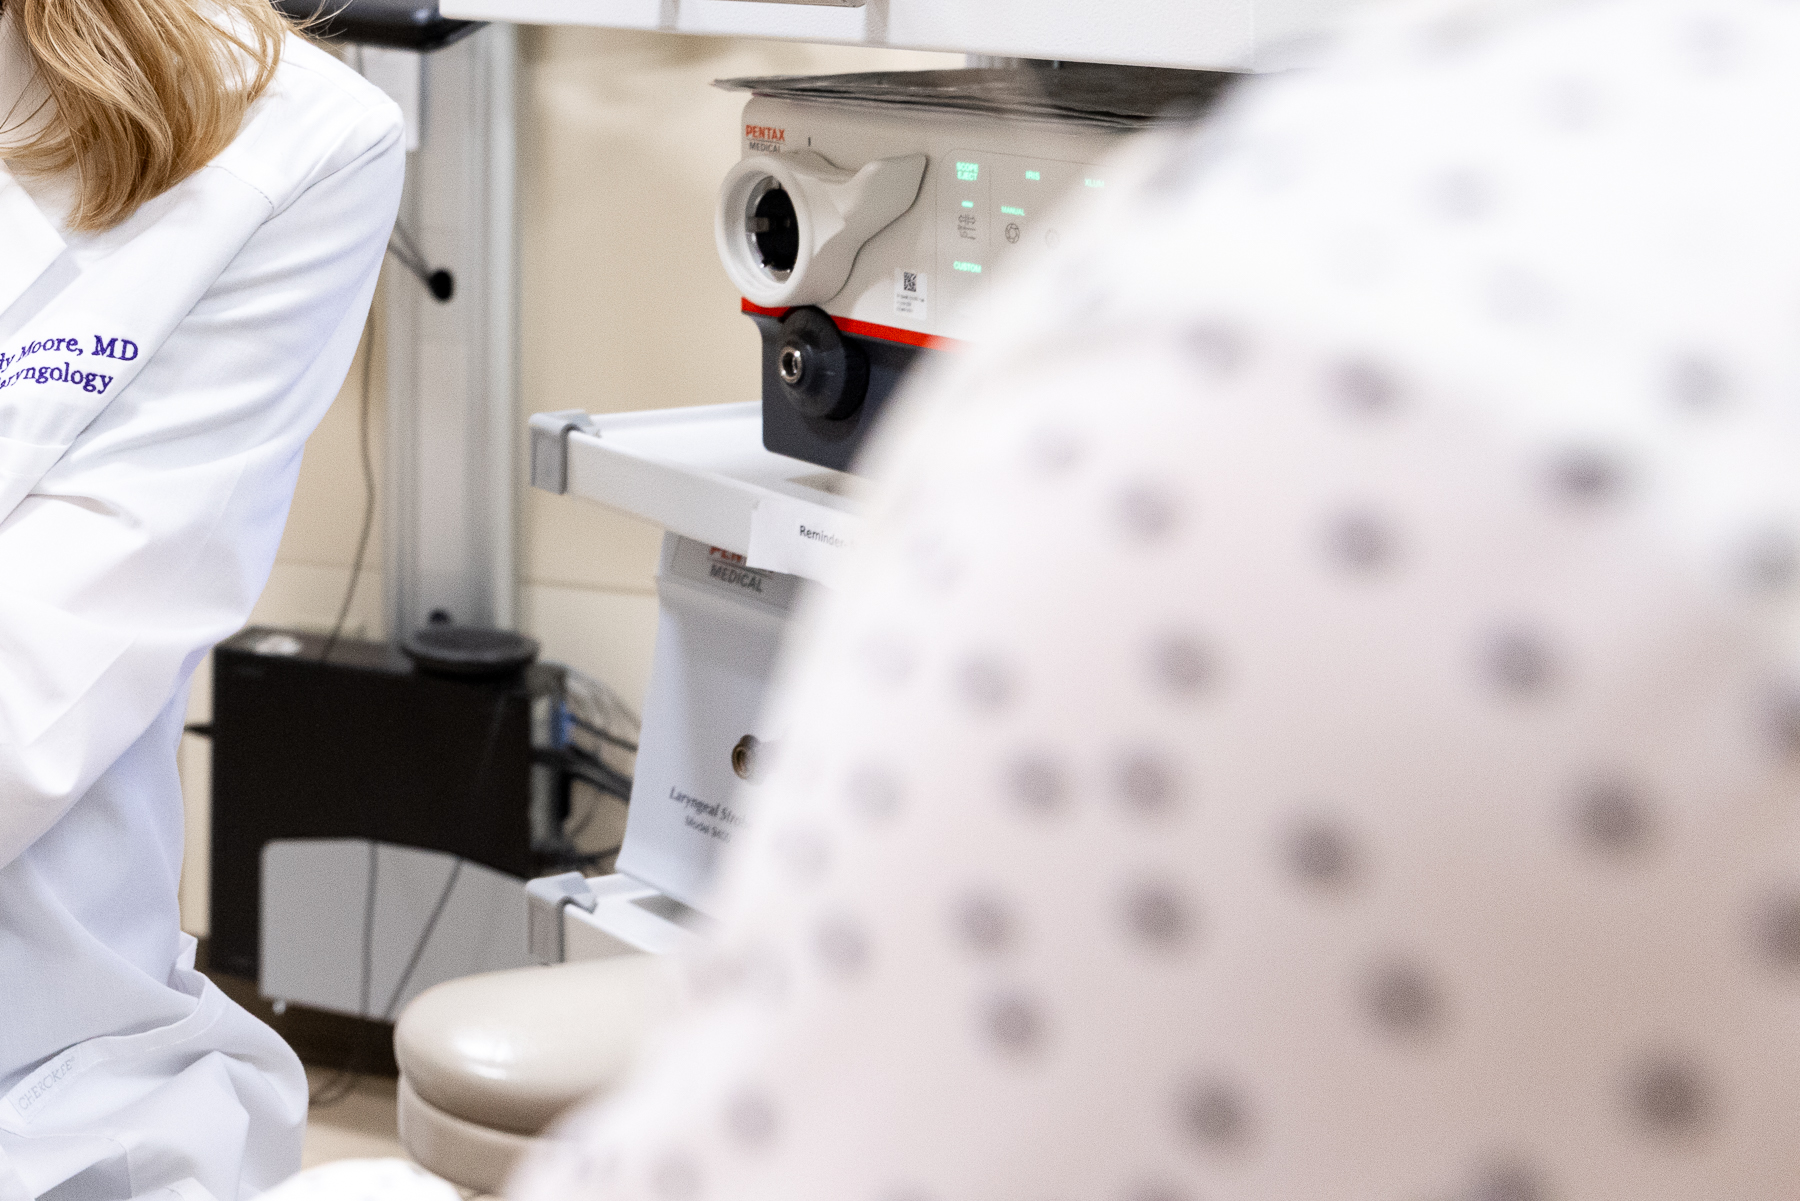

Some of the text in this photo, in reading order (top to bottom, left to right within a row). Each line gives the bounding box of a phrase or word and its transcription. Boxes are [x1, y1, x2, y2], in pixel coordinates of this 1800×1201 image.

[745, 124, 786, 142] PENTAX
[956, 161, 979, 173] SCOPE
[957, 171, 978, 181] EJECT
[1025, 170, 1041, 181] IRIS
[1001, 205, 1025, 216] MANUAL
[953, 260, 982, 273] CUSTOM
[16, 337, 83, 363] Moore,
[91, 335, 139, 361] MD
[710, 564, 763, 593] MEDICAL
